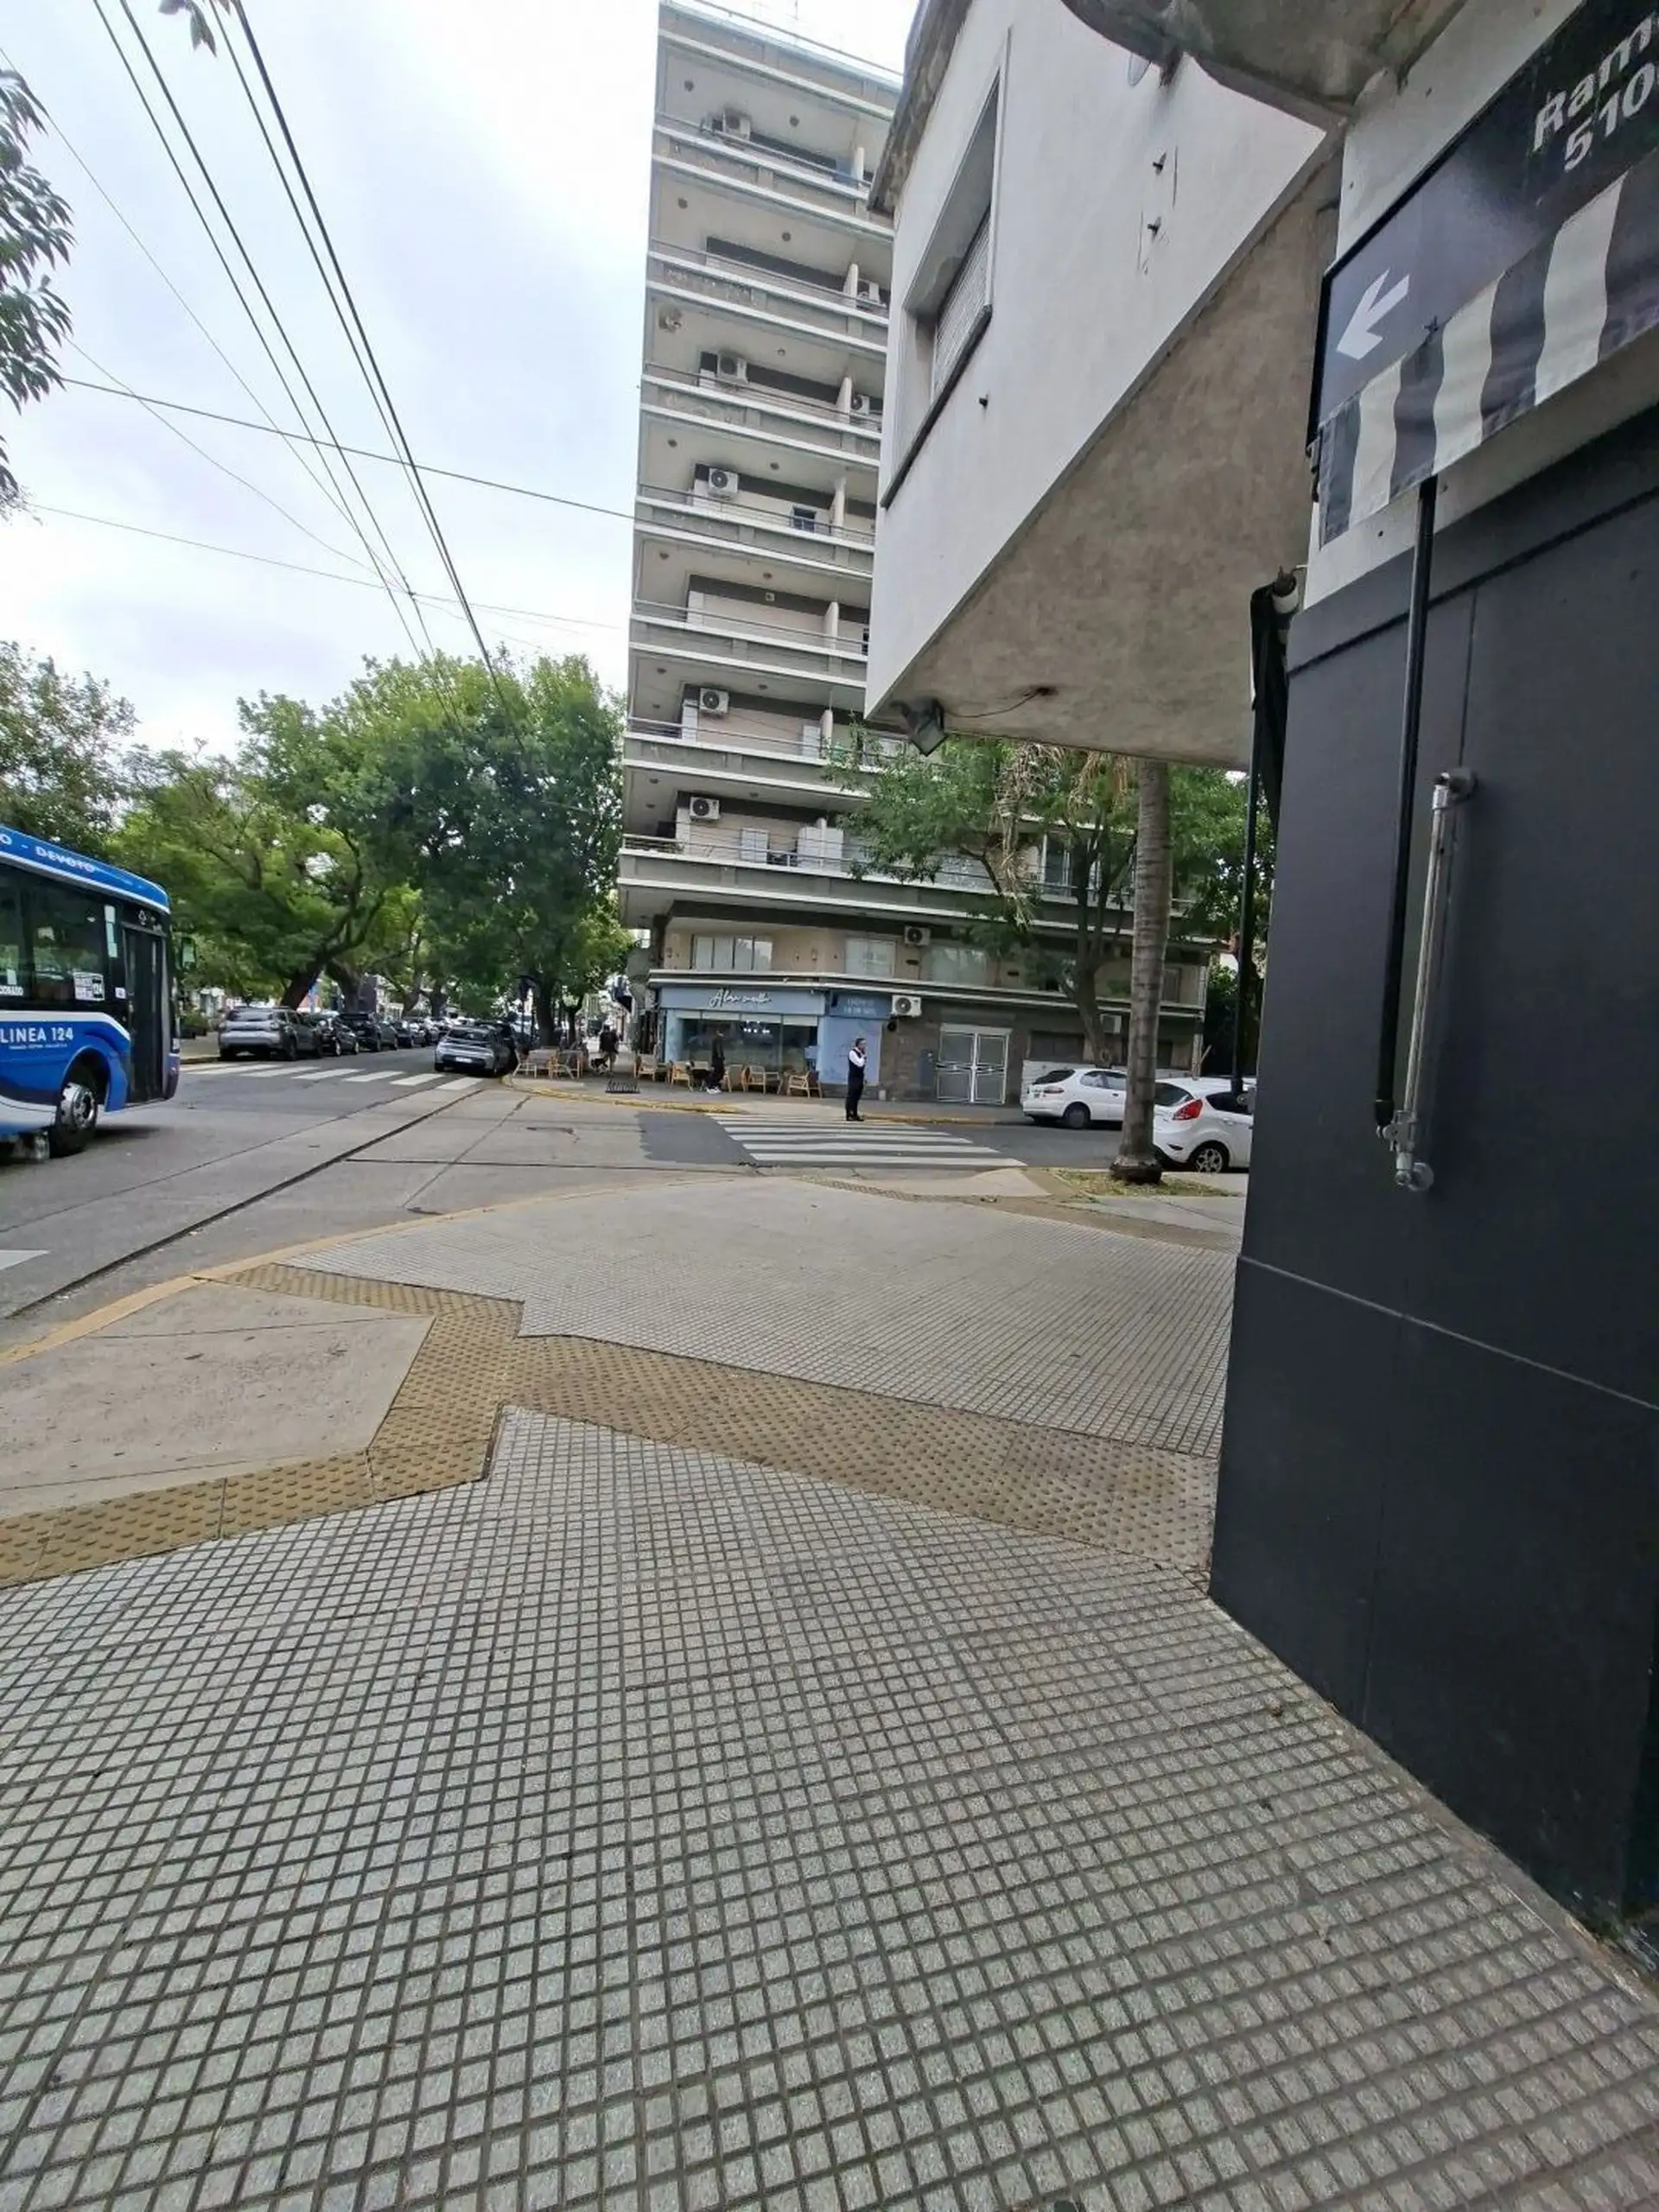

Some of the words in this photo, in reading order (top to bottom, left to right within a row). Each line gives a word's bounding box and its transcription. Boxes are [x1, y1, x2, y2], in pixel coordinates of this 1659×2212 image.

[1533, 13, 1659, 152] Ram
[1564, 61, 1659, 171] 510
[0, 1027, 47, 1044] LINEA
[51, 1027, 74, 1041] 124
